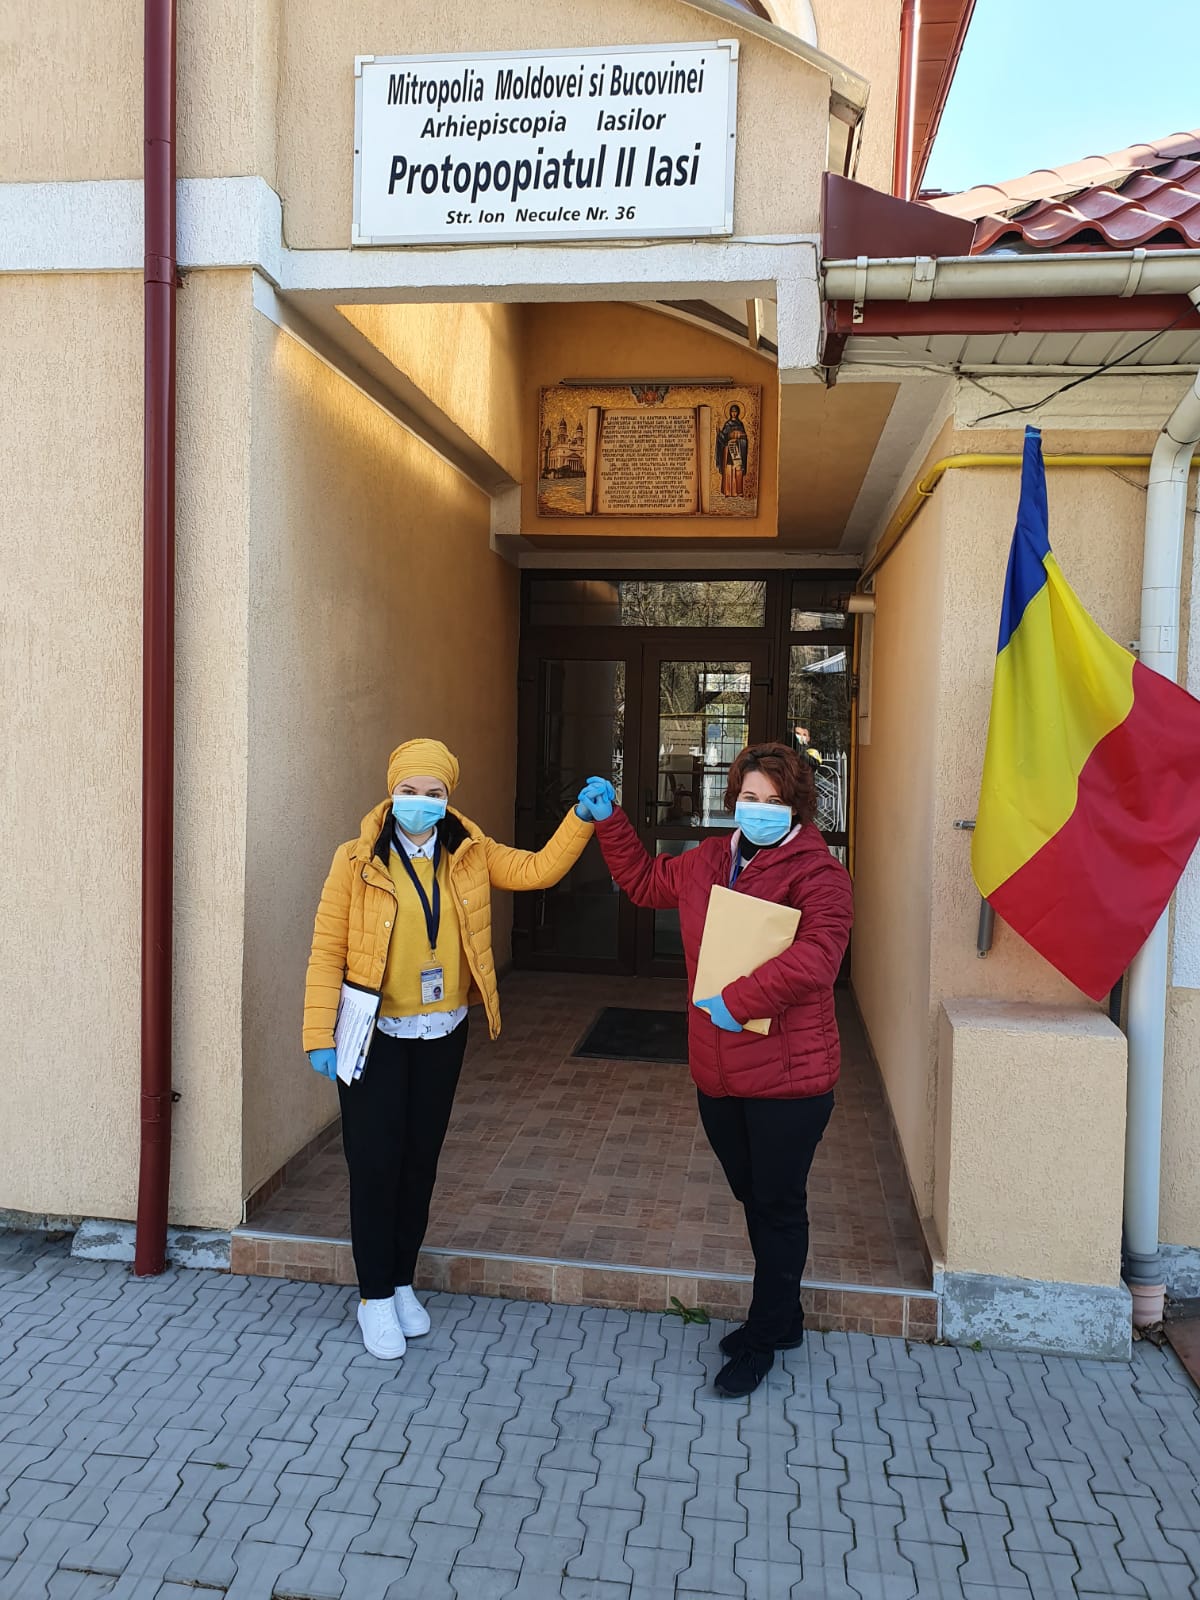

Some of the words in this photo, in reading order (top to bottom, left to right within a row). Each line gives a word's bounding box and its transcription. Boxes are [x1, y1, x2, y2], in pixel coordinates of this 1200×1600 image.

[387, 69, 484, 112] Mitropolia
[495, 65, 585, 101] Moldovei
[588, 64, 606, 98] si
[609, 59, 706, 96] Bucovinei
[420, 111, 567, 141] Arhiepiscopia
[596, 109, 667, 131] Iasilor
[387, 144, 606, 203] Protopopiatul
[614, 147, 636, 188] II
[644, 143, 702, 187] Iasi
[445, 210, 473, 225] Str.
[478, 210, 505, 224] Ion
[515, 207, 581, 222] Neculce
[586, 207, 609, 221] Nr.
[614, 206, 636, 220] 36
